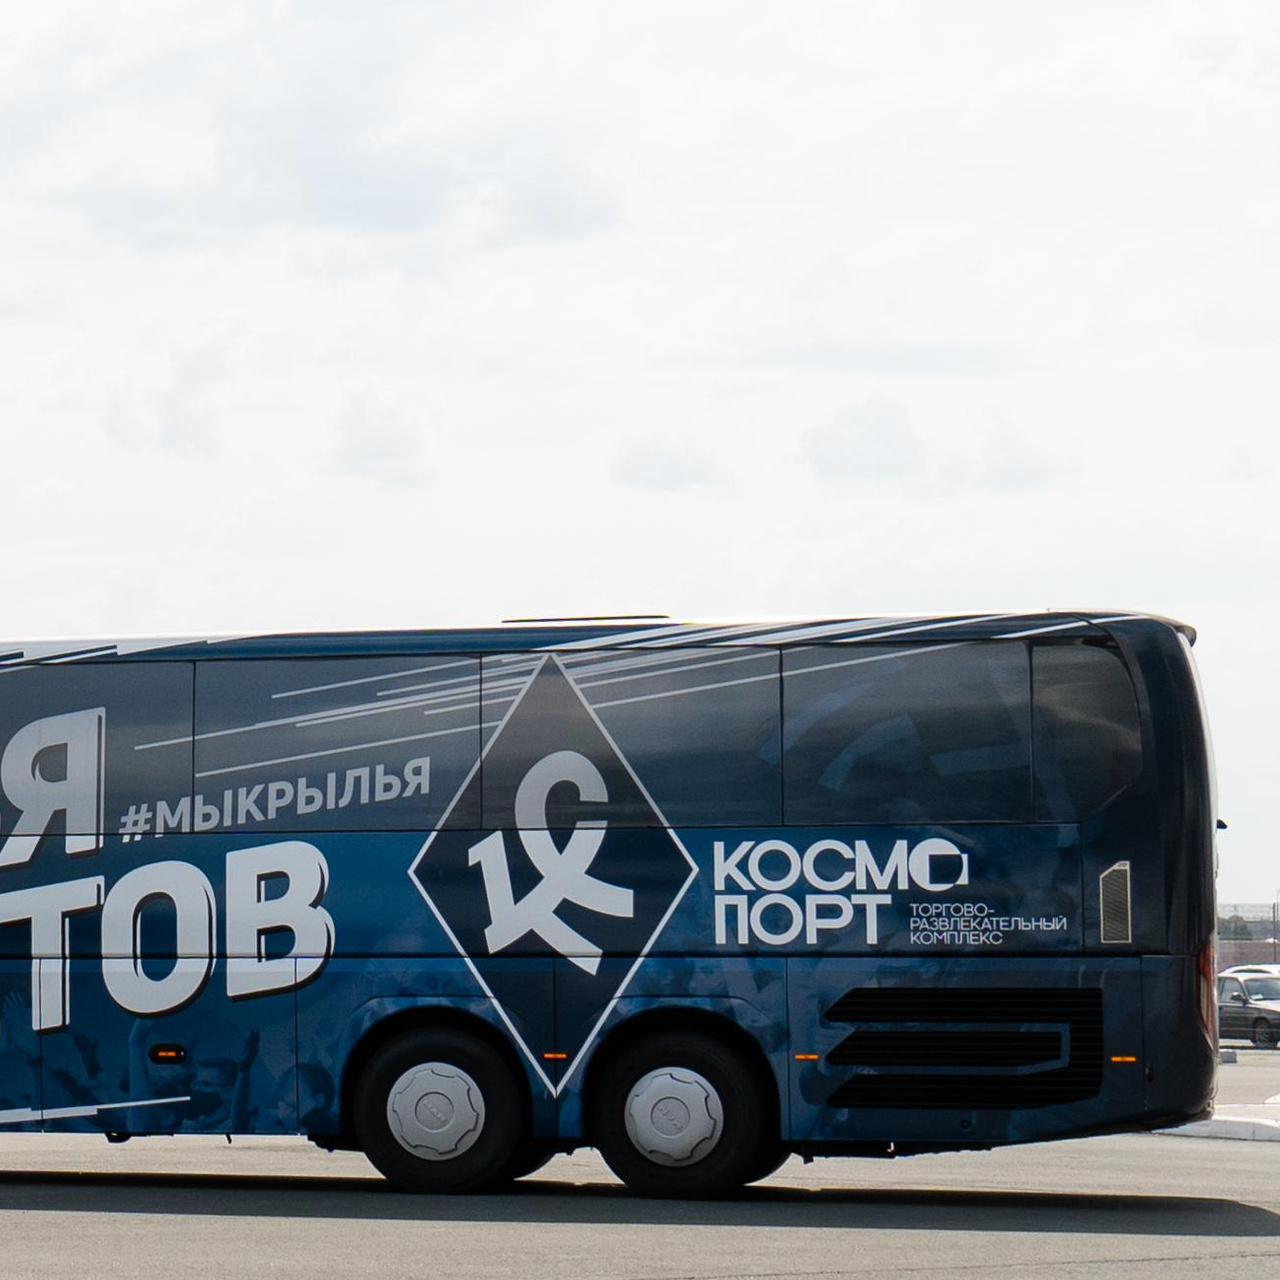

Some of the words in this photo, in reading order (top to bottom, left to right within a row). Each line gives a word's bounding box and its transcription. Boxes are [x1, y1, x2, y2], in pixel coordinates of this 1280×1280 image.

[118, 756, 431, 843] #МЫКРЫЛЬЯ
[909, 903, 995, 917] ТОРГОВО-
[714, 893, 892, 945] ПОРТ
[910, 914, 1068, 931] РАЗВЛЕКАТЕЛЬНЫЙ
[910, 931, 1003, 945] КОМПЛЕКС
